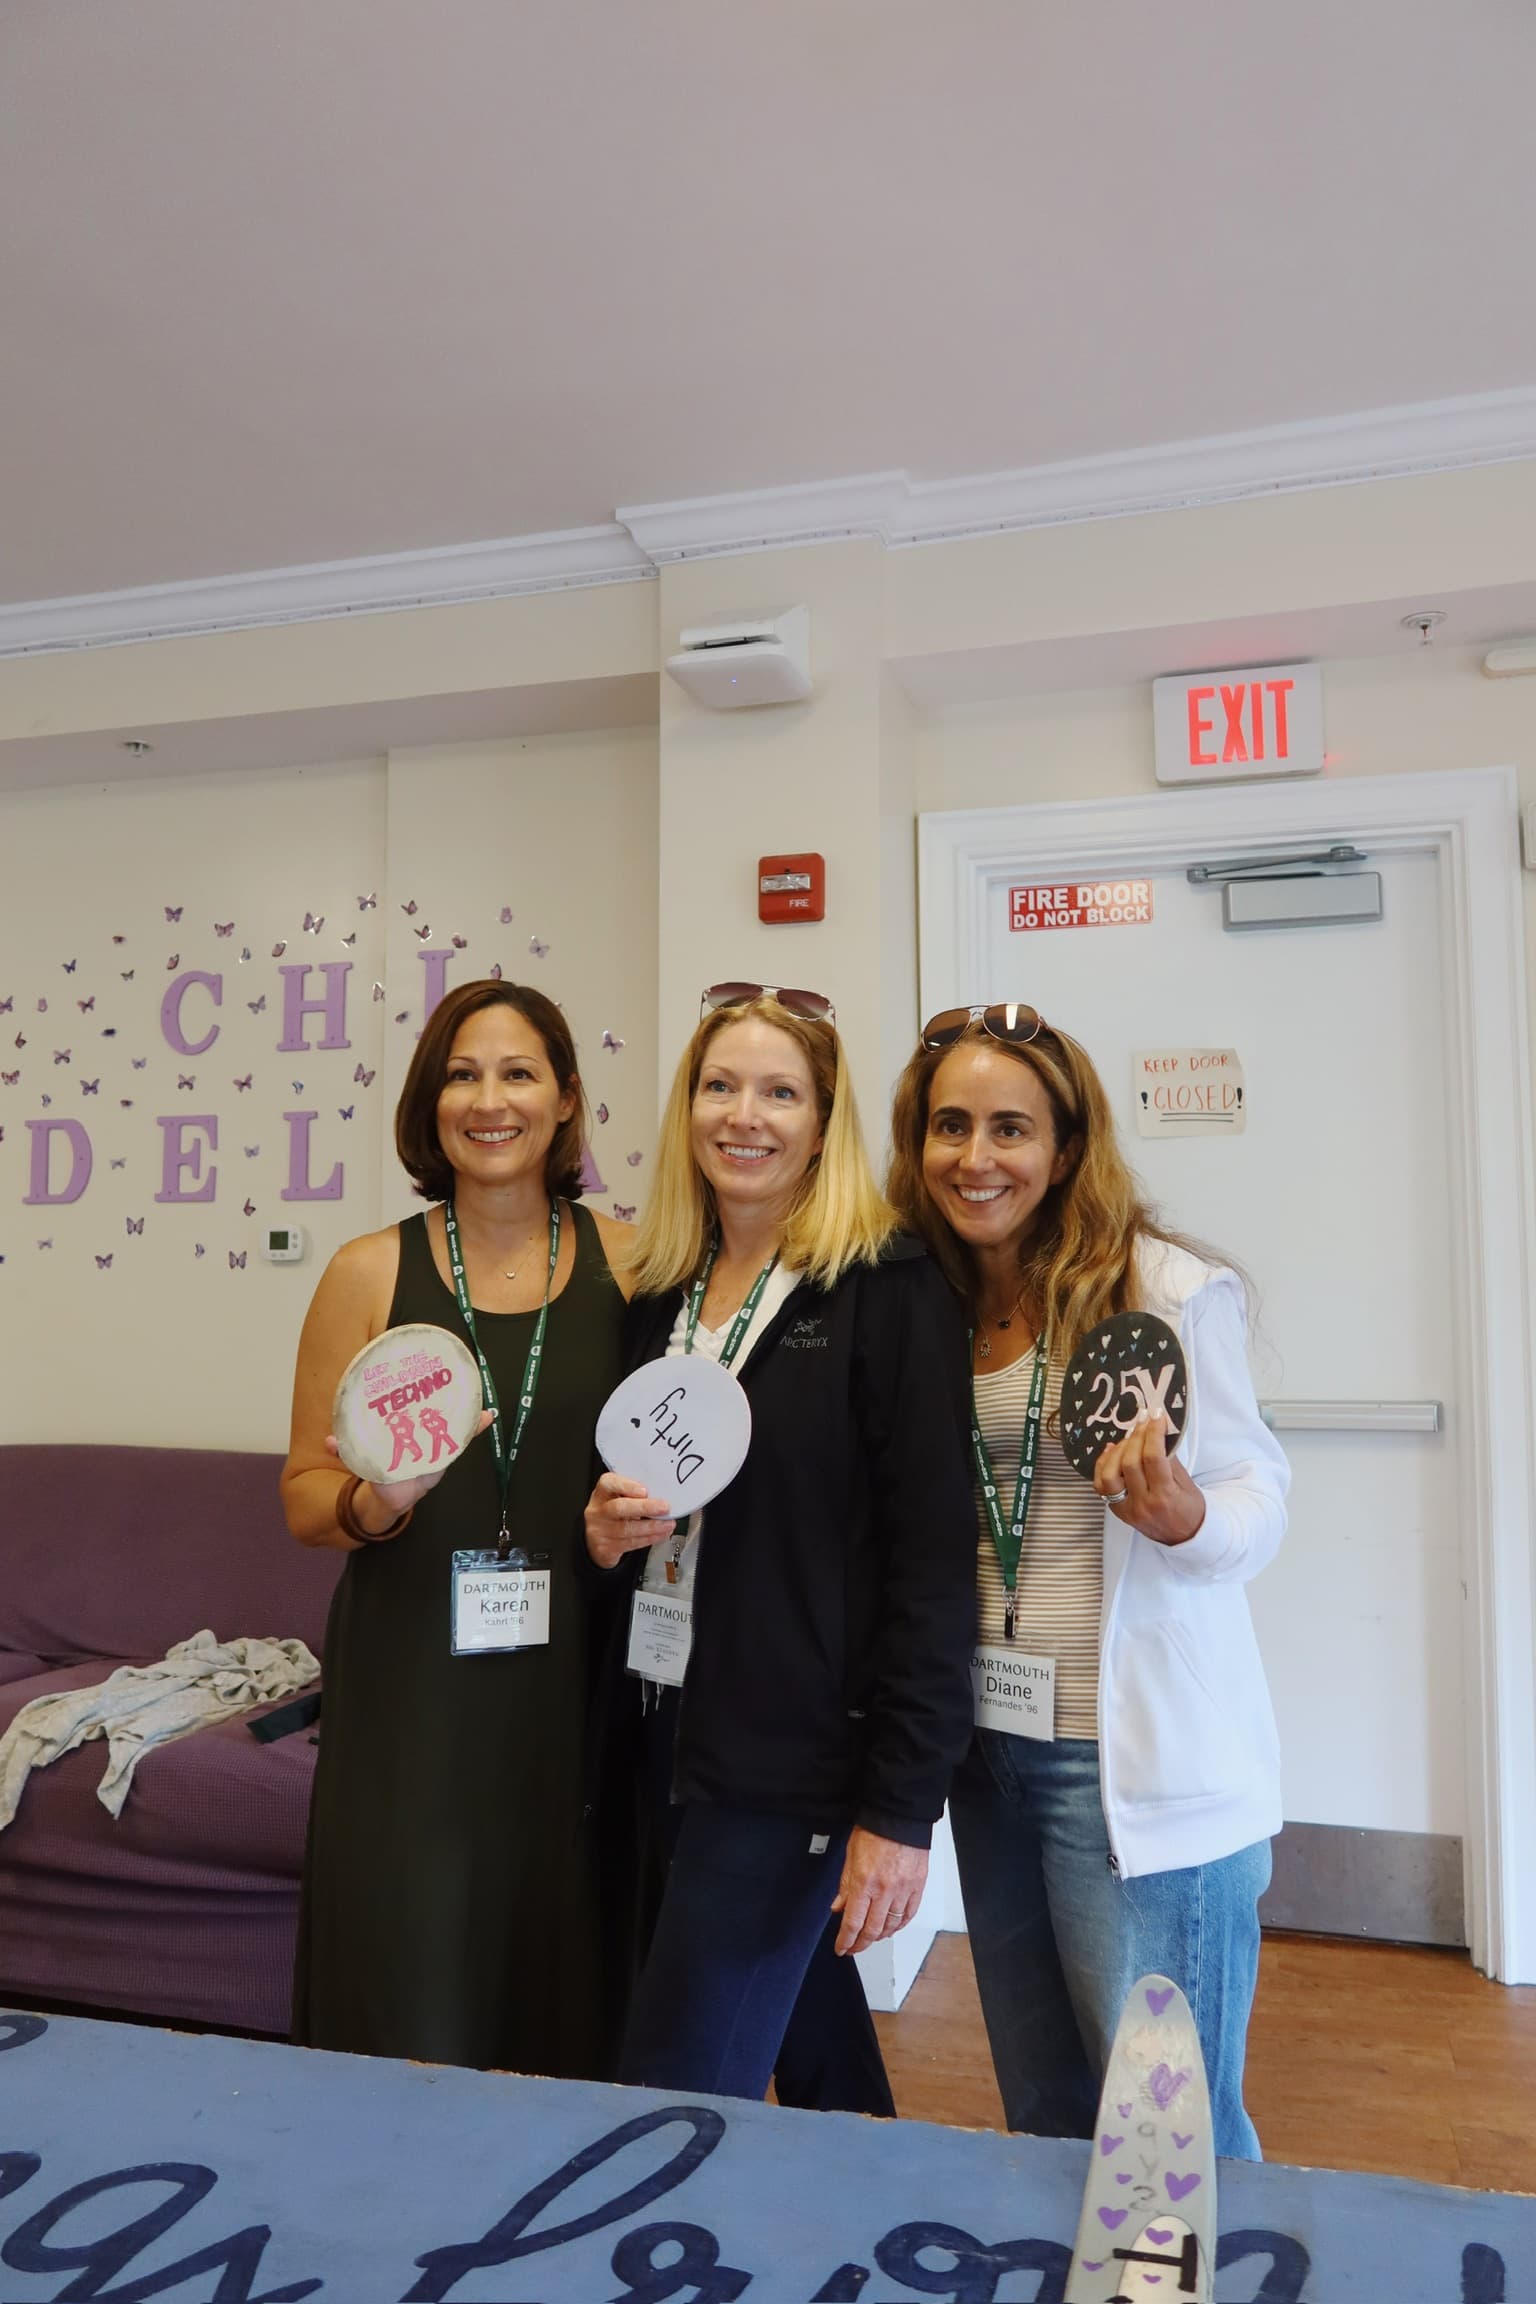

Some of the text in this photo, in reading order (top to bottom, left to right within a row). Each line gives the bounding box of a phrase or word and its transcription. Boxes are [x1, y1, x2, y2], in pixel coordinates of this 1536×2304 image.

[1187, 679, 1294, 766] EXIT
[788, 898, 809, 909] FIRE
[1013, 882, 1149, 911] FIRE DOOR
[1013, 905, 1149, 928] DO NOT BLOCK
[1144, 1054, 1228, 1073] KEEP DOOR
[367, 1367, 453, 1418] TECHNO
[649, 1387, 705, 1485] Dirty
[463, 1580, 546, 1594] DARTMOUTH
[480, 1599, 529, 1615] Karen
[970, 1656, 1050, 1681] DARTMOUTH
[986, 1676, 1032, 1700] Diane
[979, 1695, 1039, 1715] Fernandes '96
